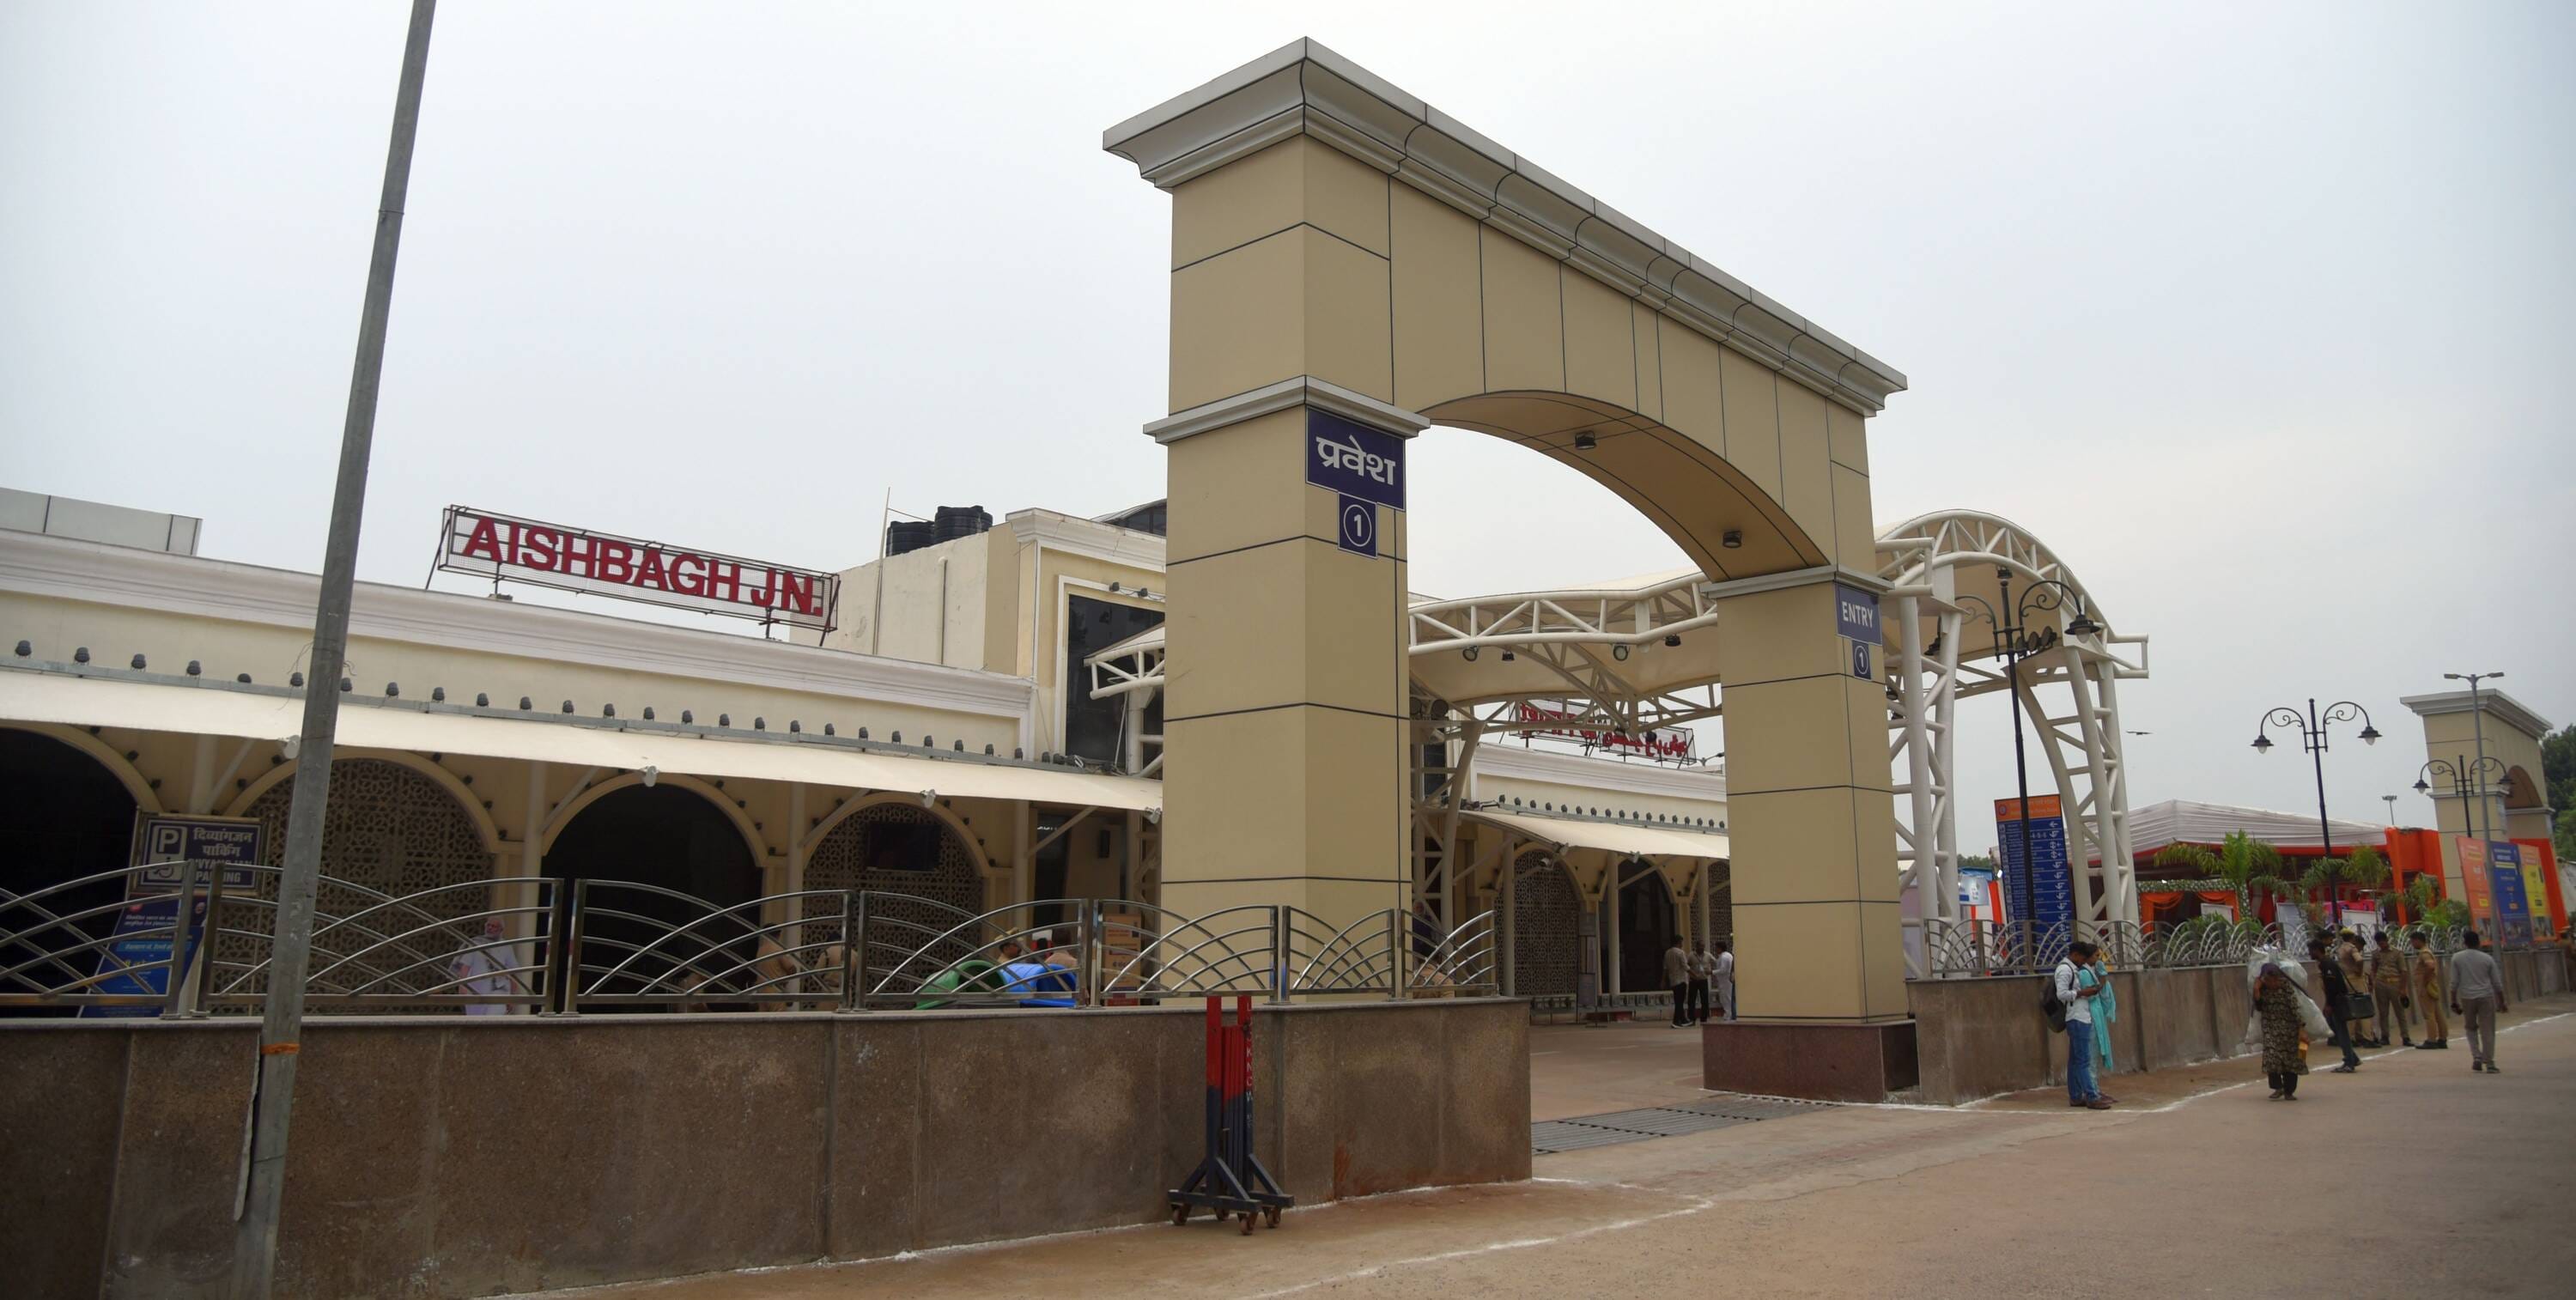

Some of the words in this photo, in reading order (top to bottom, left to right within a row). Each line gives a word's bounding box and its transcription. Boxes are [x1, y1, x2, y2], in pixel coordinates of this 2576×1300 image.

[1315, 434, 1396, 486] प्रवेश
[1353, 513, 1362, 538] 1
[463, 516, 741, 603] AISHBAGH
[750, 567, 824, 617] JN.
[1841, 600, 1874, 629] ENTRY
[1859, 652, 1864, 667] 1
[159, 828, 179, 853] P
[196, 870, 241, 884] PAING
